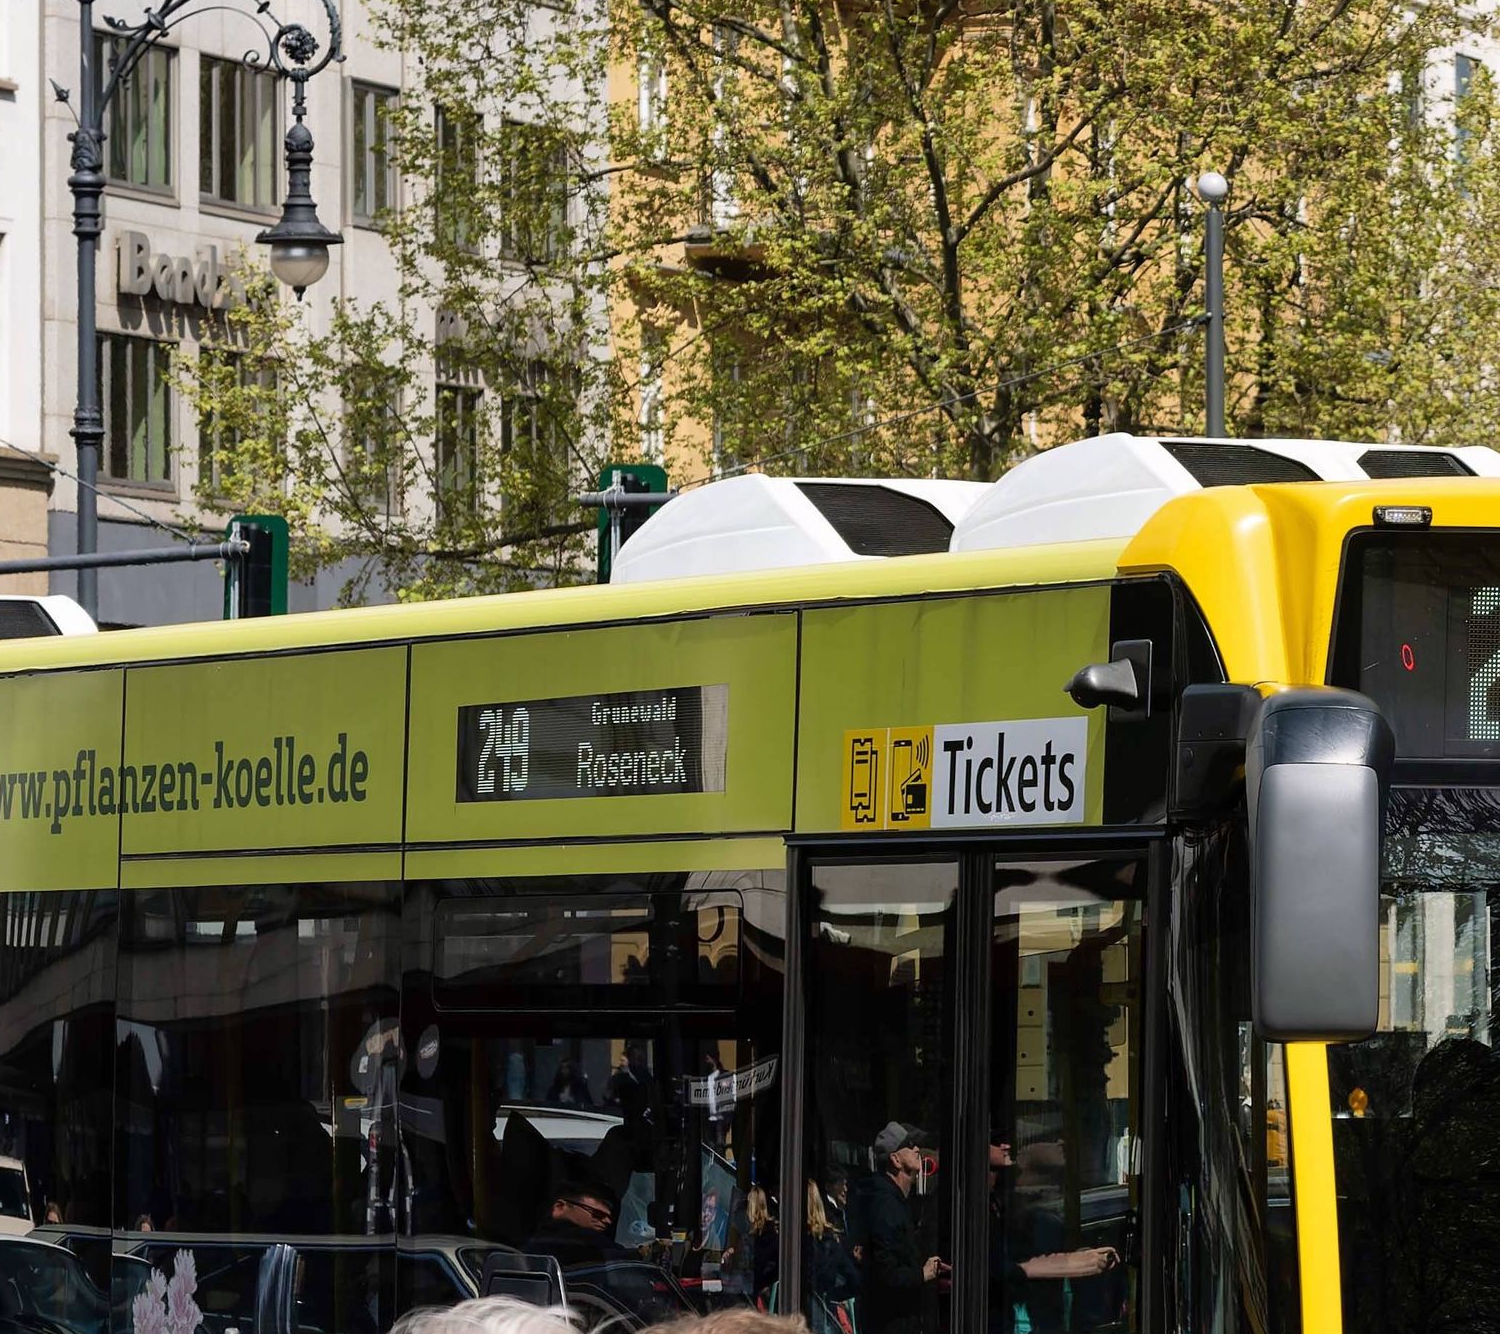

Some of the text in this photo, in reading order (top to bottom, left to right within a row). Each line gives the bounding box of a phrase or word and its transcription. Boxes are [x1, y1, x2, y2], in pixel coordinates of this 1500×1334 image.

[477, 707, 530, 794] 249
[576, 736, 687, 788] Roseneck
[943, 732, 1075, 815] Tickets
